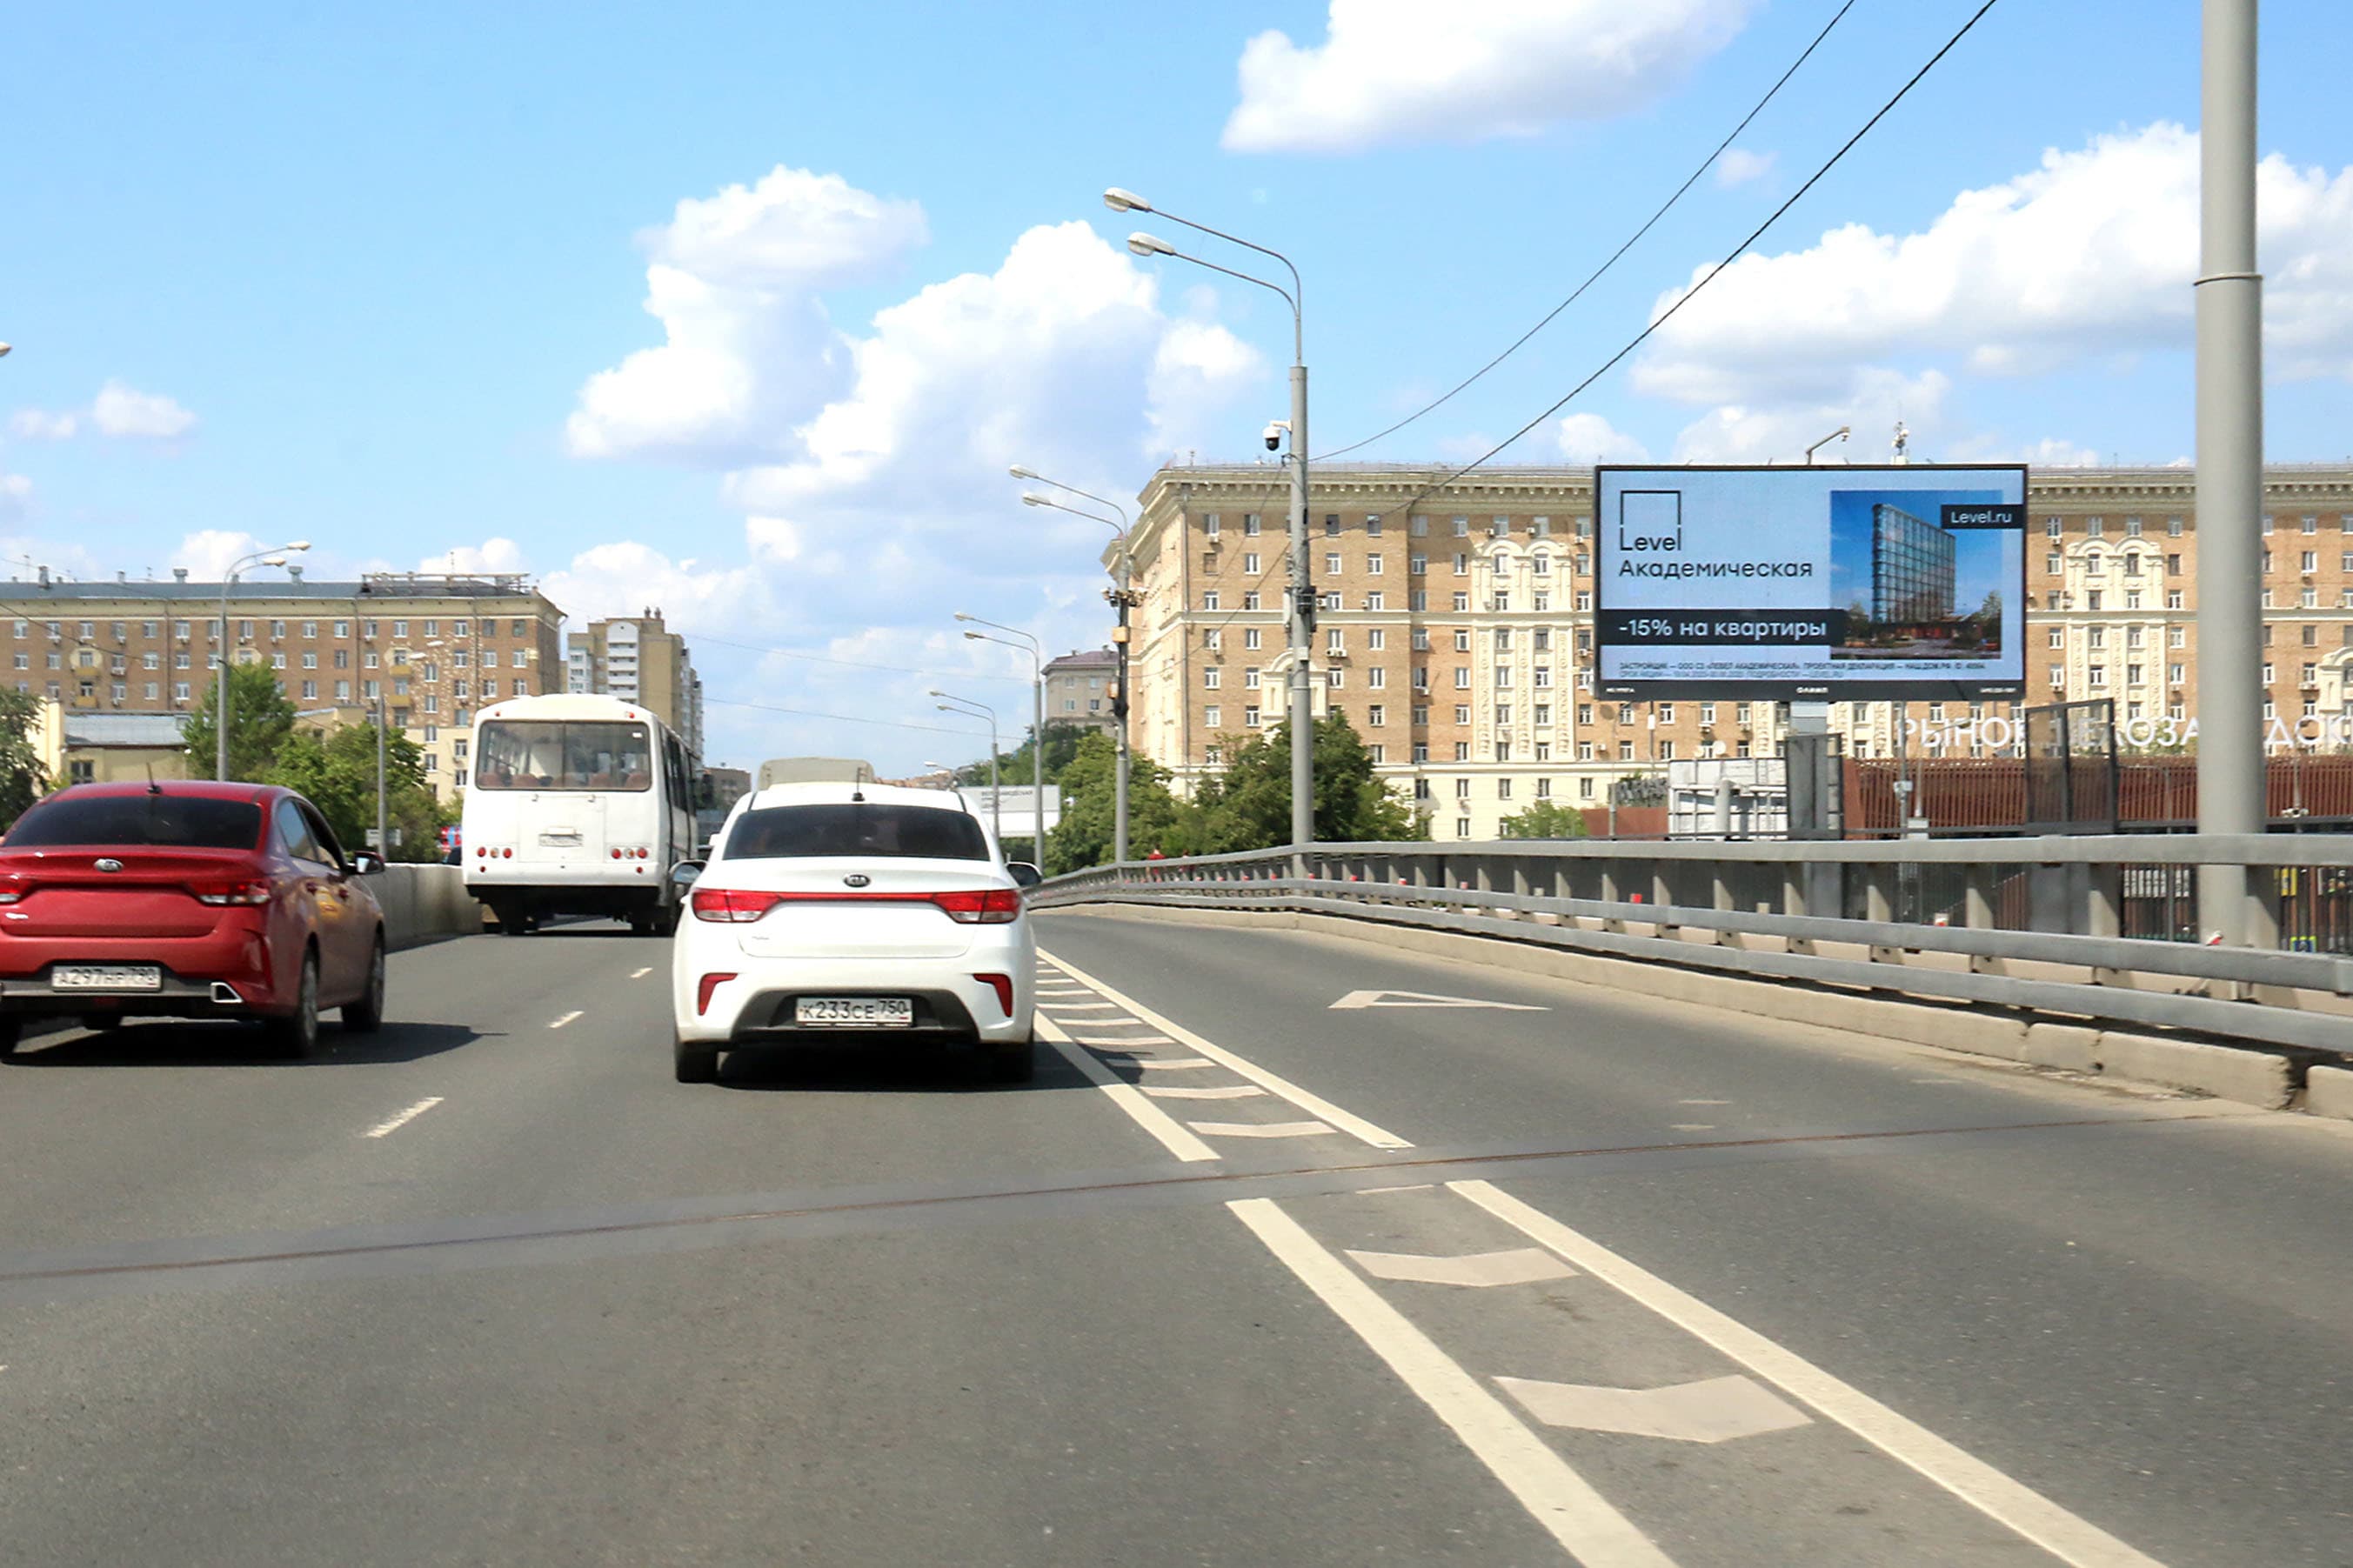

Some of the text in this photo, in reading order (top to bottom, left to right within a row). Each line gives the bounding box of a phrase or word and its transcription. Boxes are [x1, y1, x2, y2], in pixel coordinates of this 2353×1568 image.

[1950, 510, 2012, 524] Level.ru
[1620, 527, 1681, 551] Level
[1619, 560, 1813, 580] Академическая
[1619, 619, 1827, 641] -15% на квартиры
